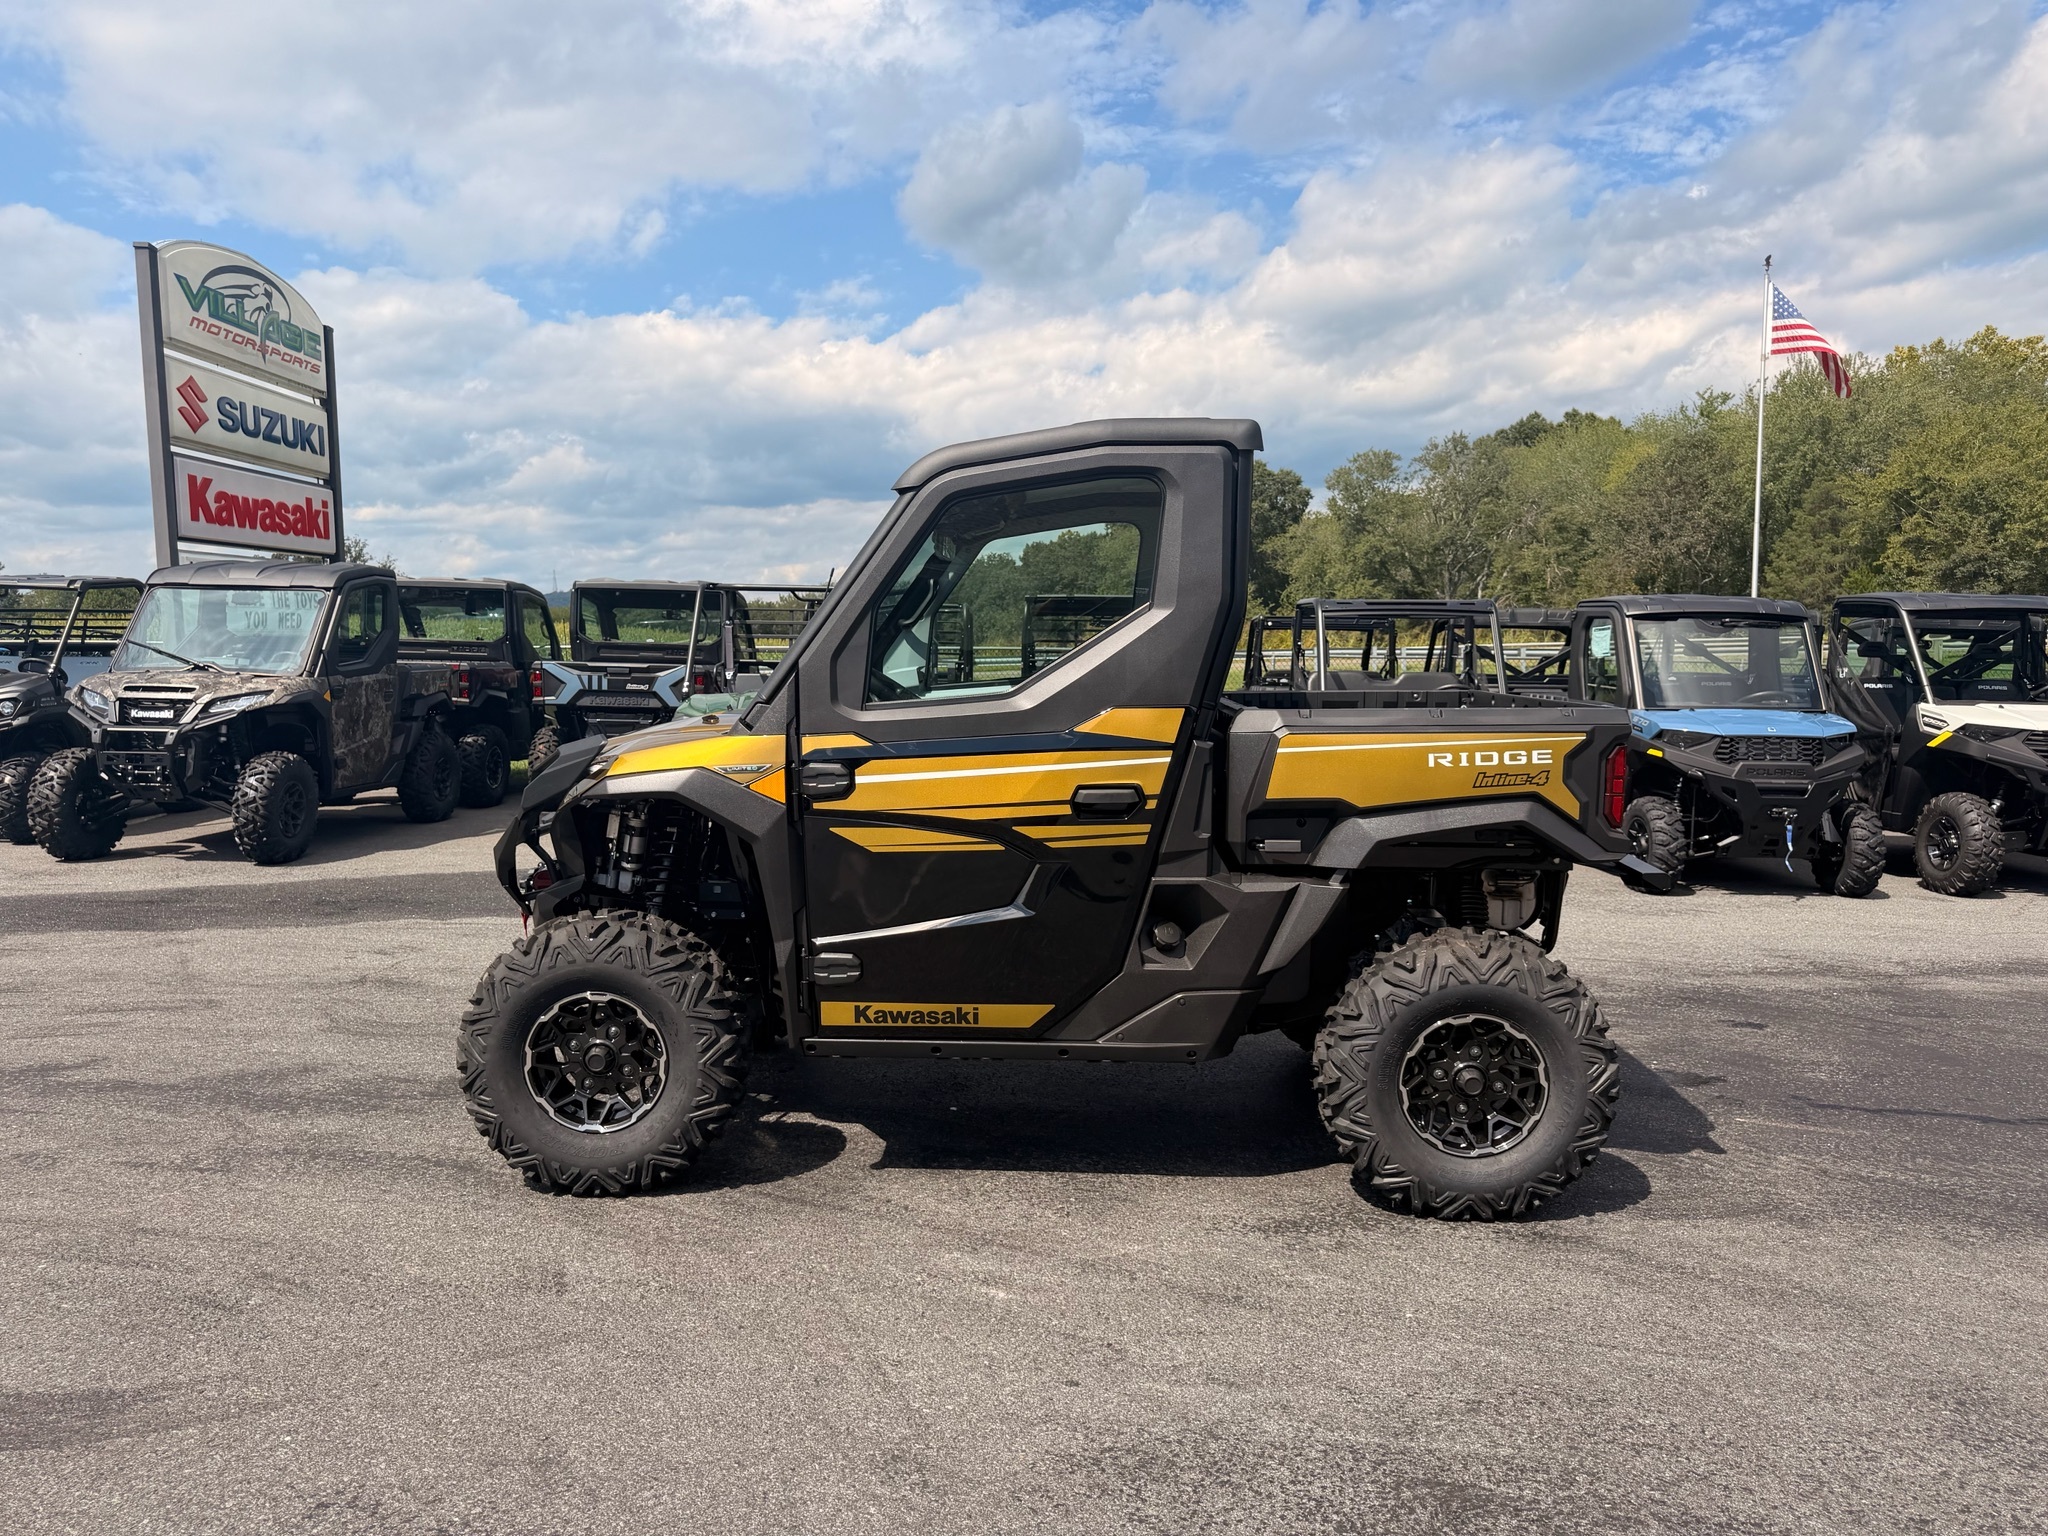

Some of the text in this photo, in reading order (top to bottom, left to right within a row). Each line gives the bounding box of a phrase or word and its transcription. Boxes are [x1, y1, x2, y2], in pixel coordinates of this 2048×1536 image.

[173, 272, 322, 365] VILLAGE
[189, 316, 321, 375] MOTORSPORTS
[217, 396, 326, 457] SUZUKI
[187, 473, 330, 540] Kawasaki
[272, 591, 290, 608] THE
[294, 592, 319, 609] TOYS
[245, 611, 302, 629] YOU NEED
[589, 695, 650, 707] Kawasaki
[130, 709, 174, 719] Kawasaki
[1632, 715, 1650, 727] 570
[1922, 716, 1949, 727] 1000
[1428, 749, 1553, 767] RIDGE
[1472, 770, 1550, 788] Inline-4
[1746, 767, 1806, 776] POLARIS
[854, 1004, 979, 1025] Kawasaki
